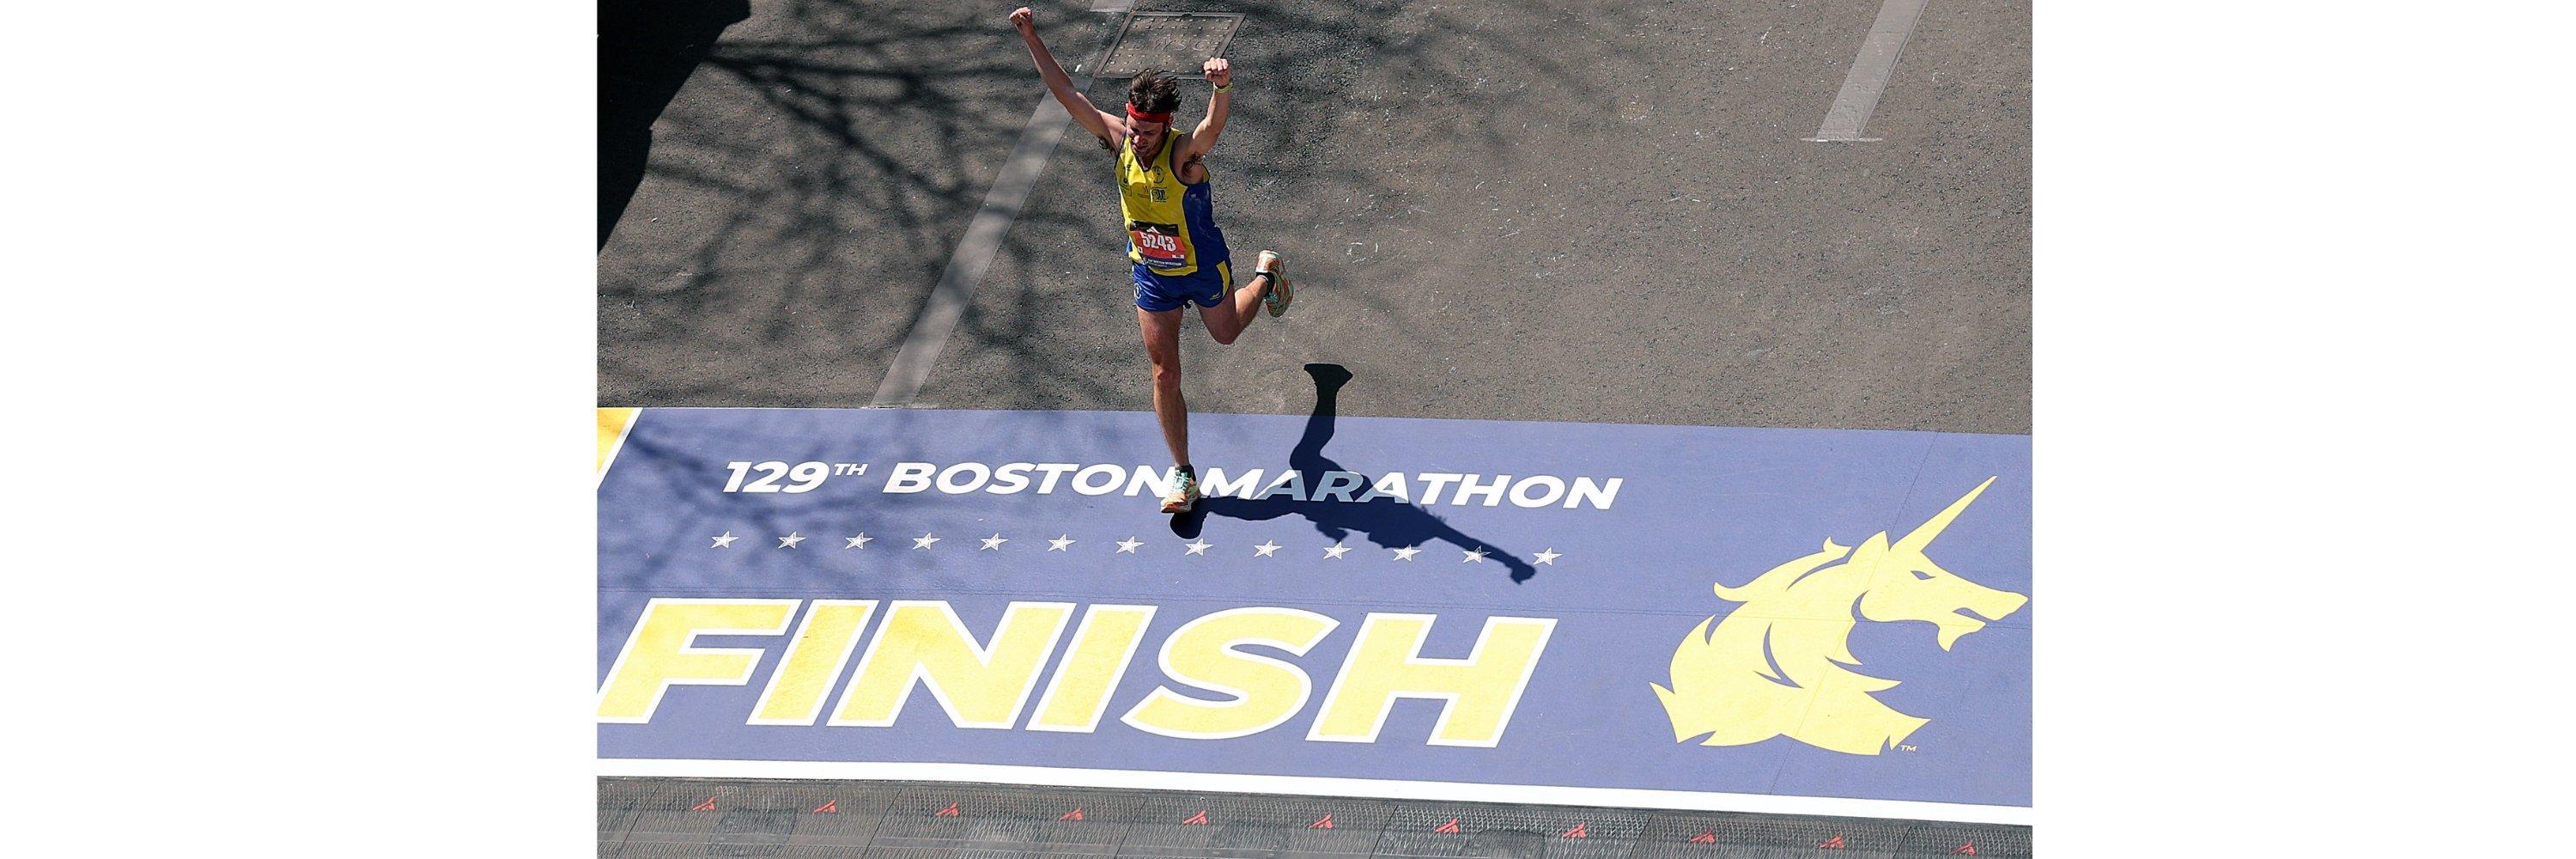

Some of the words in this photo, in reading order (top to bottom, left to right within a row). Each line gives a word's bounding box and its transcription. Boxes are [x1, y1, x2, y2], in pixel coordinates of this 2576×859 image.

[1139, 232, 1176, 252] 5243
[882, 461, 1176, 498] BOSTON
[1200, 467, 1625, 510] MARATHON
[597, 597, 1558, 748] FINISH
